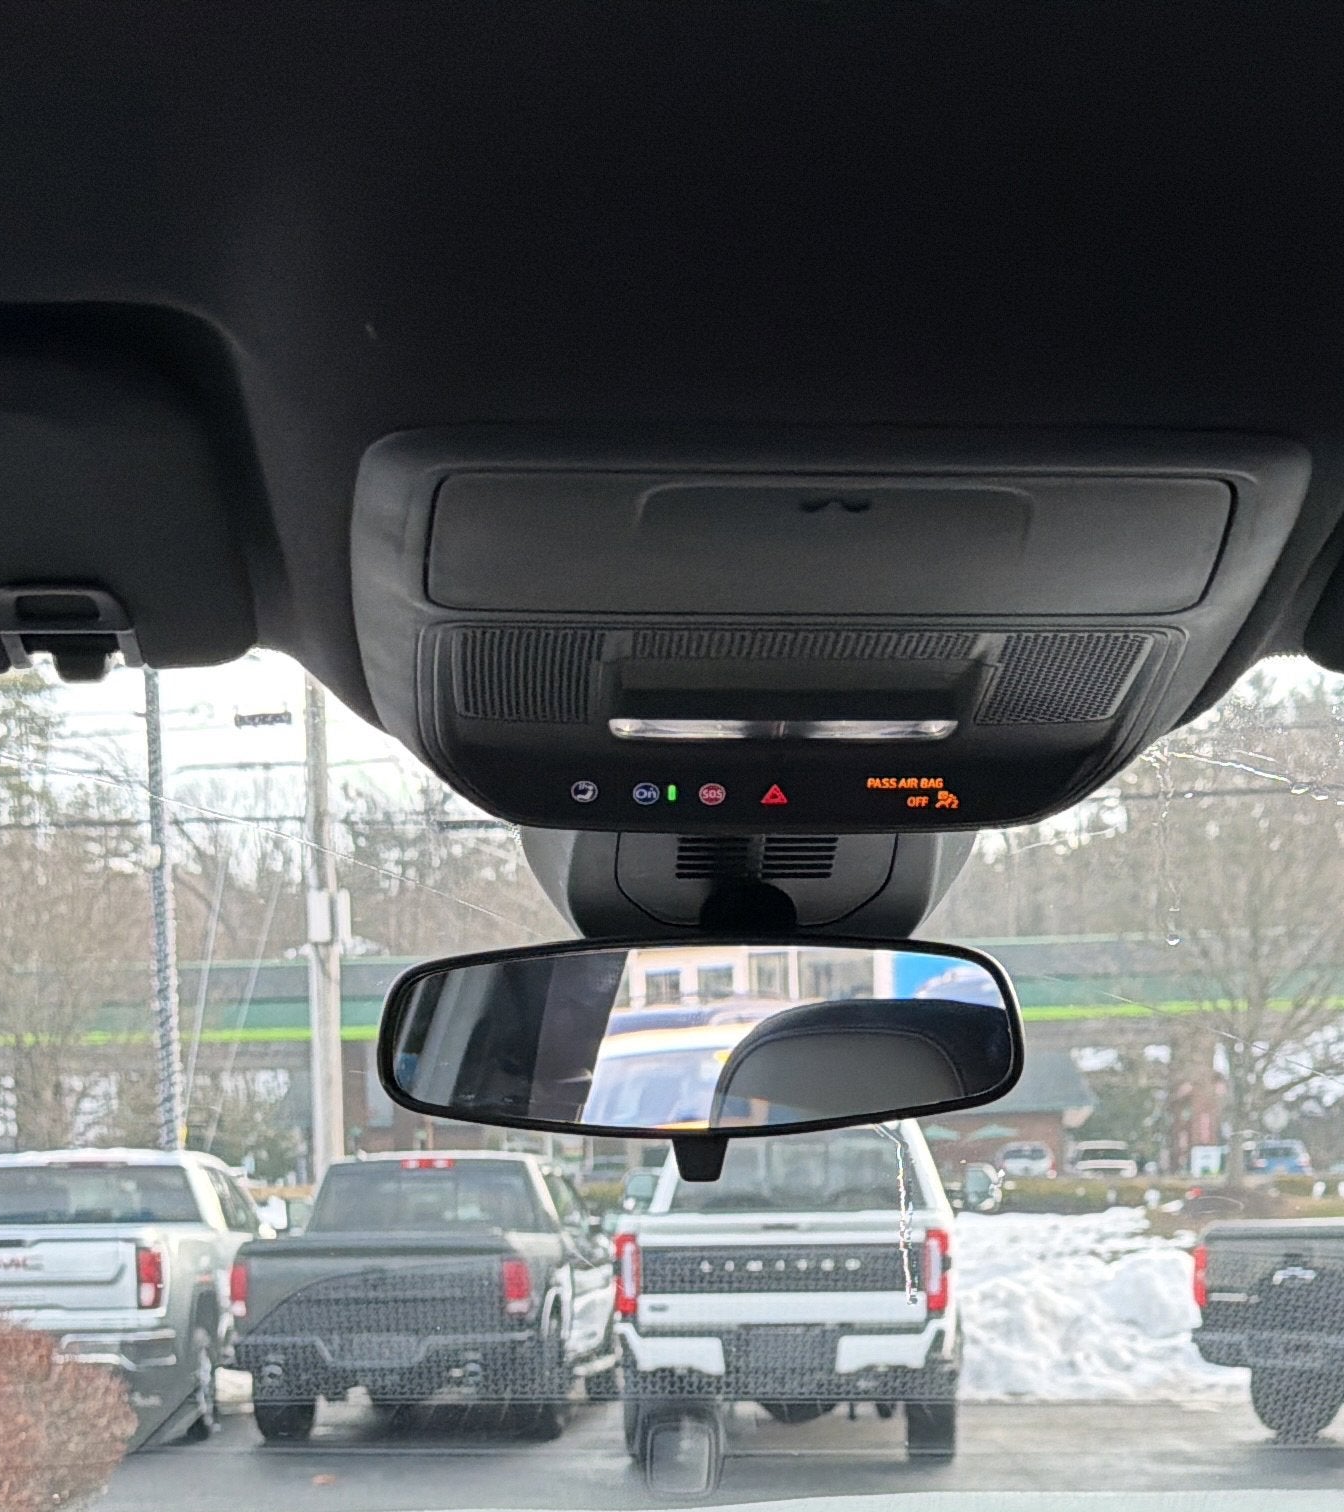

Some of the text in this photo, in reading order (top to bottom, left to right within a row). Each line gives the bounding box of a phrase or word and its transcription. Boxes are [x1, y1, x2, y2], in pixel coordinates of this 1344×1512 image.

[866, 777, 944, 789] PASS AIR BAG
[702, 789, 723, 799] SOS
[906, 796, 929, 807] OFF
